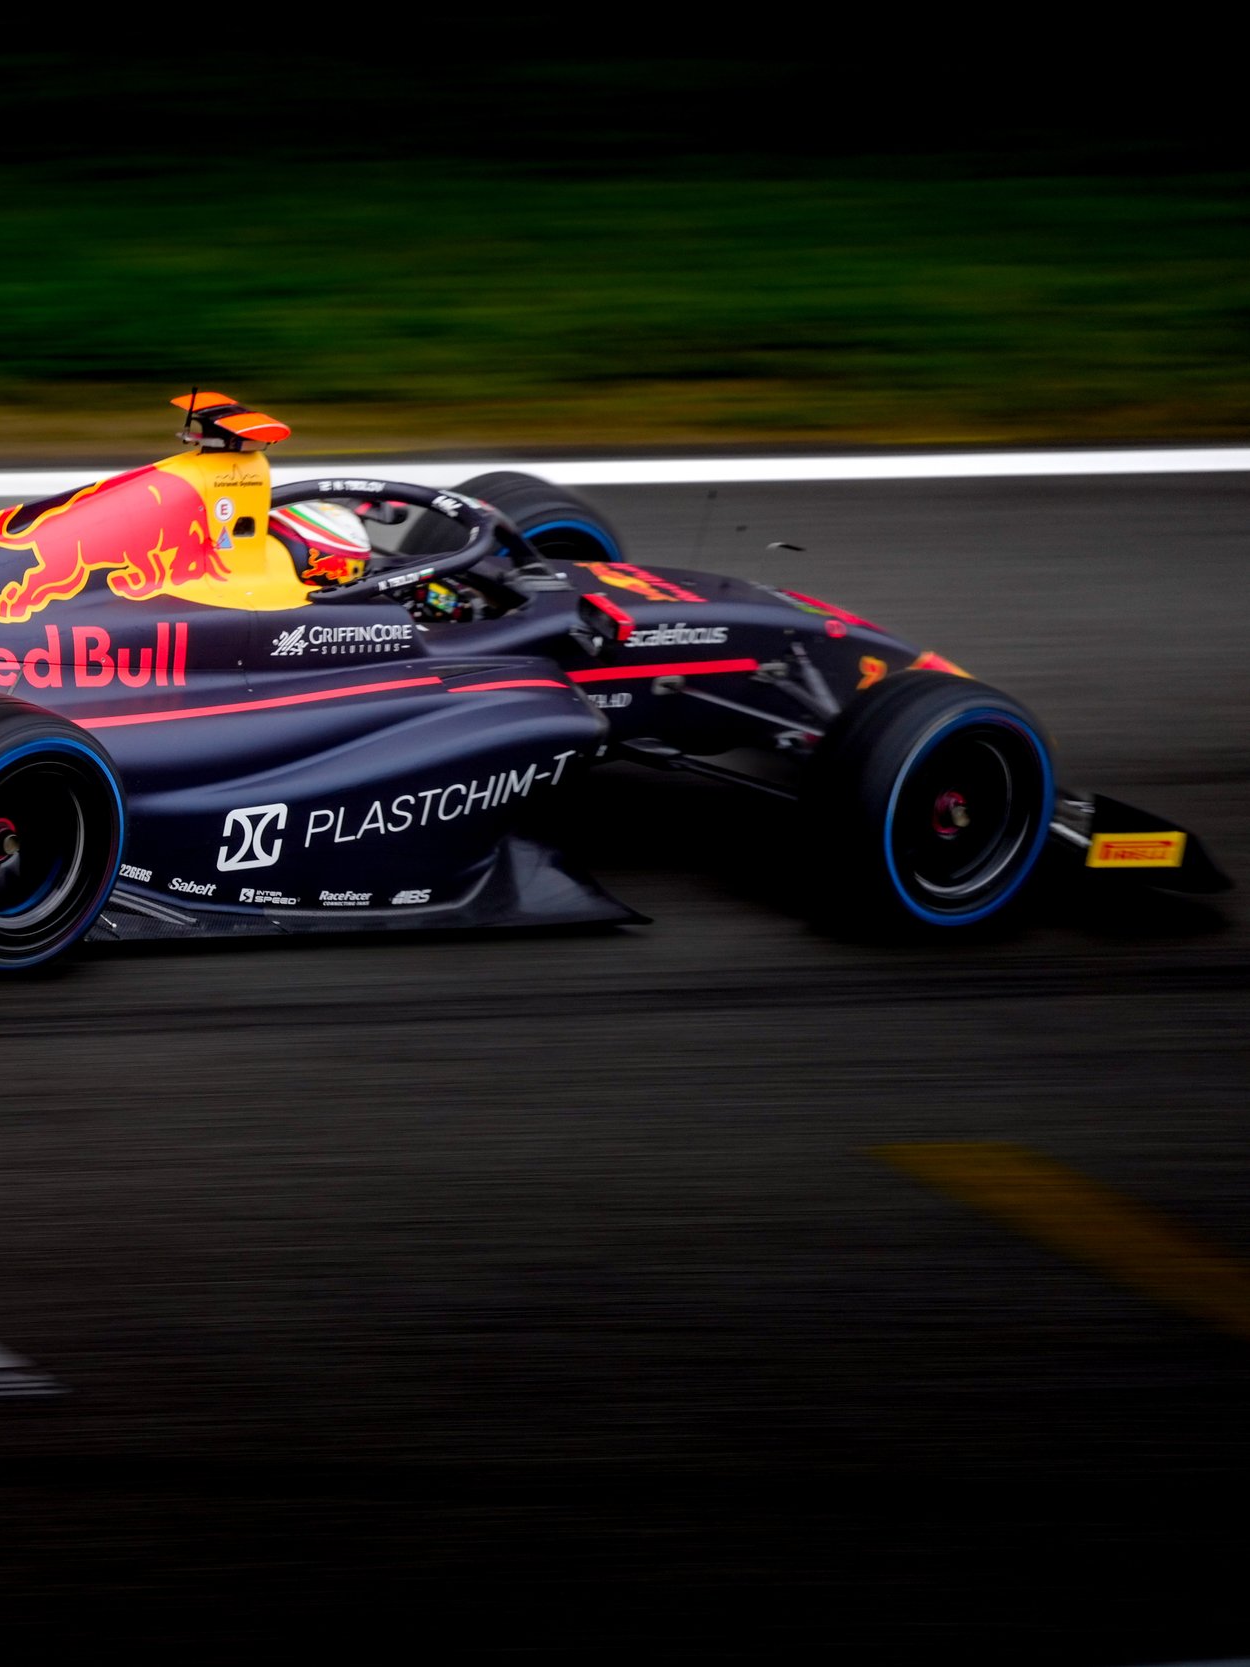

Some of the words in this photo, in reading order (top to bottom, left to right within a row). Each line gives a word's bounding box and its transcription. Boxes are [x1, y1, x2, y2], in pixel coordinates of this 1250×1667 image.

[221, 503, 229, 516] E
[624, 622, 729, 647] scalefocus
[71, 622, 188, 688] Bull
[303, 749, 577, 848] PLASTCHIM-T
[119, 863, 153, 883] 226ERS
[168, 877, 217, 897] Sabelt
[318, 890, 373, 901] RaceFacer
[254, 896, 297, 905] SPEED
